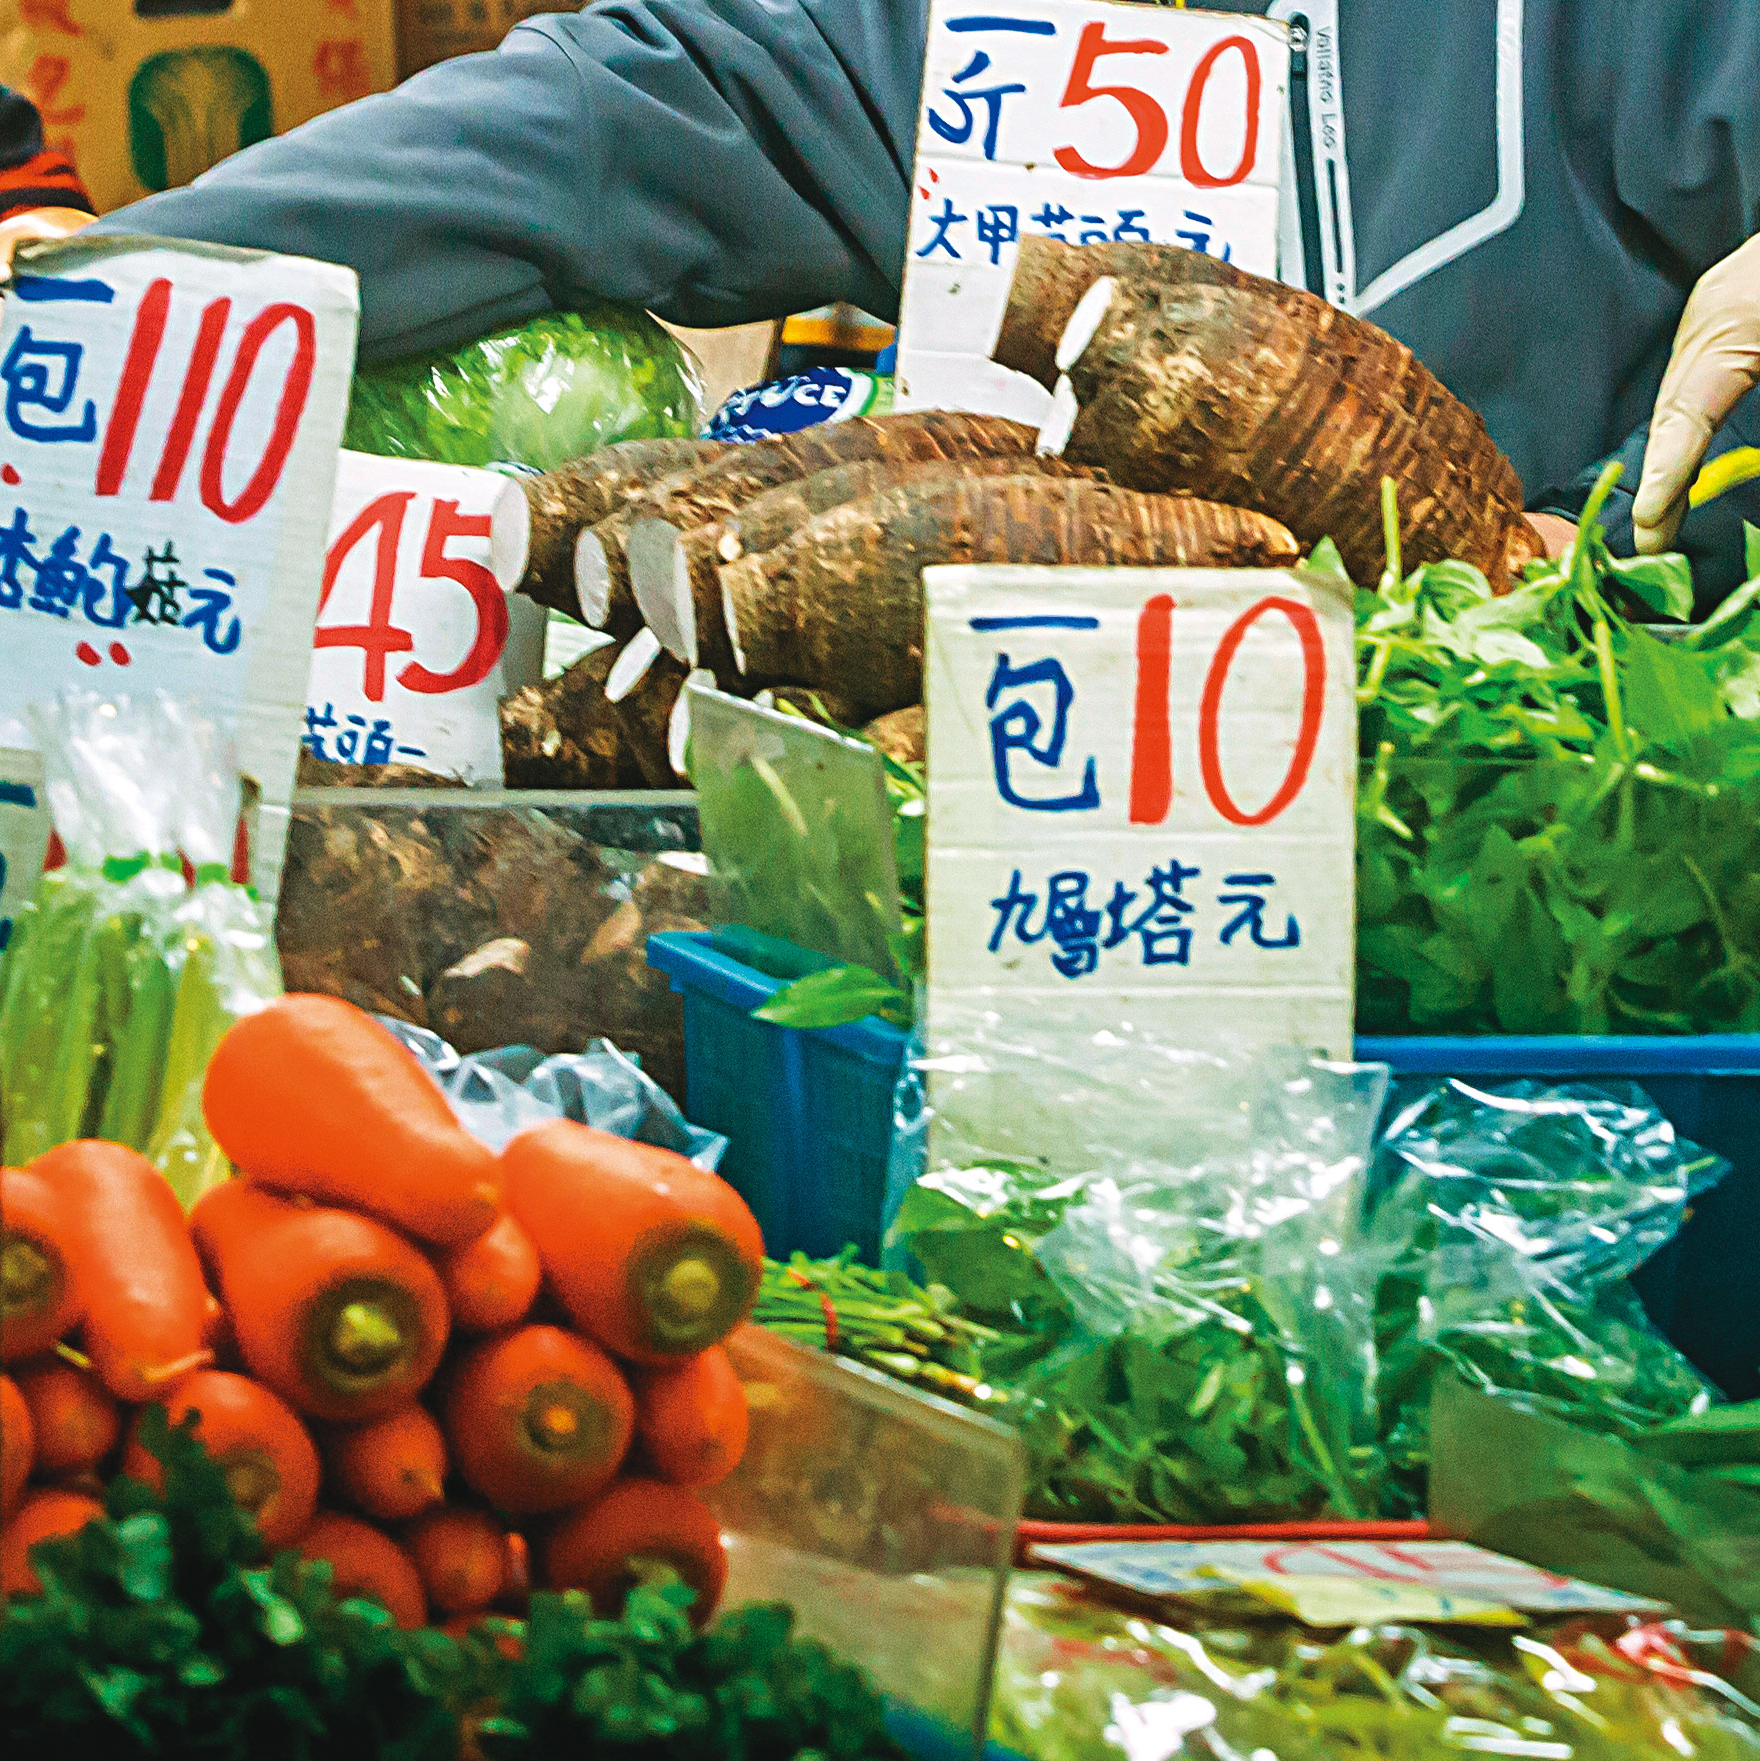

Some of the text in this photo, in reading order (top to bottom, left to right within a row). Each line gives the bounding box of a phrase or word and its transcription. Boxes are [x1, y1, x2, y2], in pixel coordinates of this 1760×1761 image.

[1051, 20, 1262, 189] 50
[94, 276, 317, 524] 110
[313, 490, 509, 703] 45
[1128, 593, 1326, 827] 10
